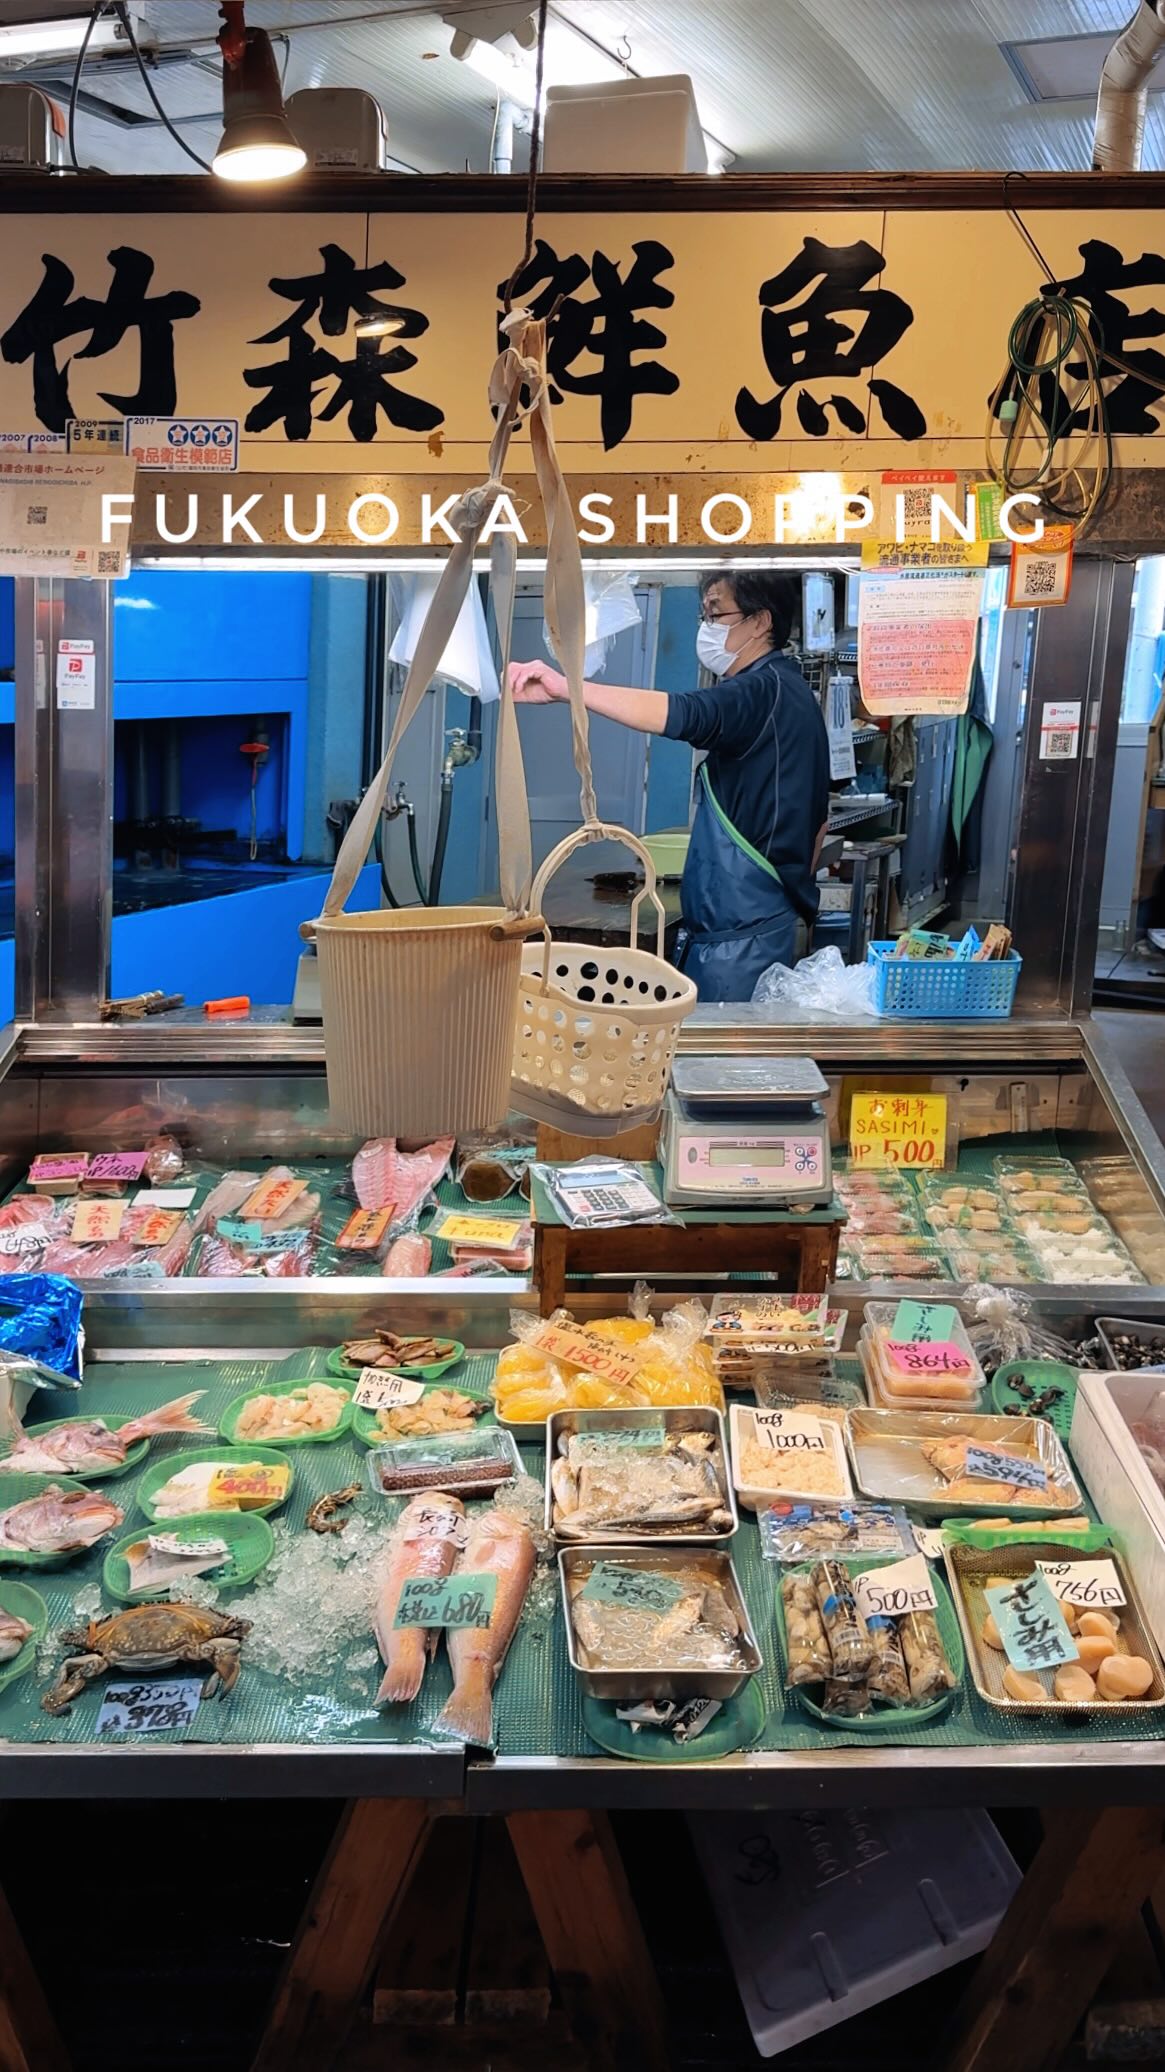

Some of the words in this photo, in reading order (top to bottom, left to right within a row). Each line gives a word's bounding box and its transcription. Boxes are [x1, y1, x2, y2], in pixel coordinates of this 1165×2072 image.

[134, 417, 155, 425] 2017
[2, 434, 25, 442] 2007
[132, 447, 233, 465] 食品衛生模範店
[880, 552, 969, 566] 流通事業者の皆さまへ
[856, 1118, 926, 1135] SASIMI
[904, 1351, 970, 1369] 864円
[866, 1586, 934, 1613] 500円
[1055, 1578, 1124, 1605] 756円
[1000, 1580, 1067, 1666] さしみ用
